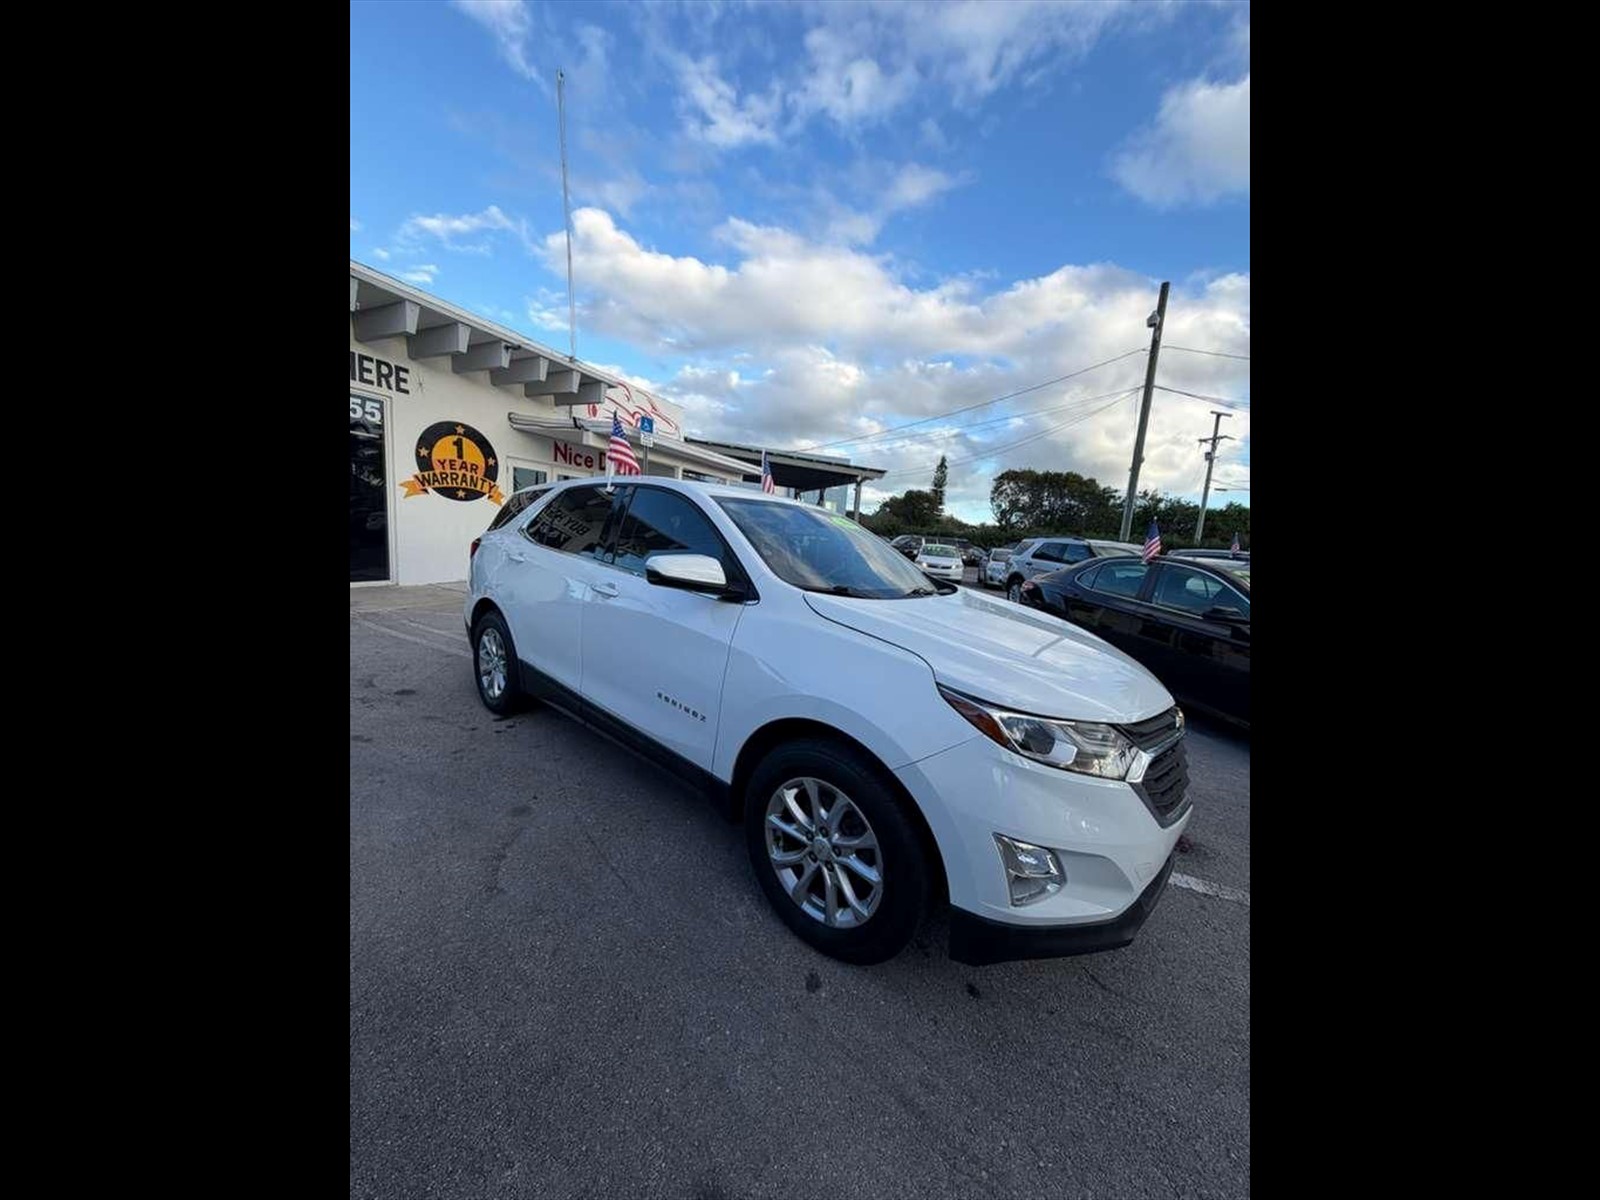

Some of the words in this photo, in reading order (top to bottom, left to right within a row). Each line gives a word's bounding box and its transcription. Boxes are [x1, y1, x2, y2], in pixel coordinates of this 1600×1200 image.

[452, 437, 464, 459] 1
[553, 440, 594, 469] Nice
[437, 458, 479, 475] YEAR
[414, 471, 497, 495] WARRANTY
